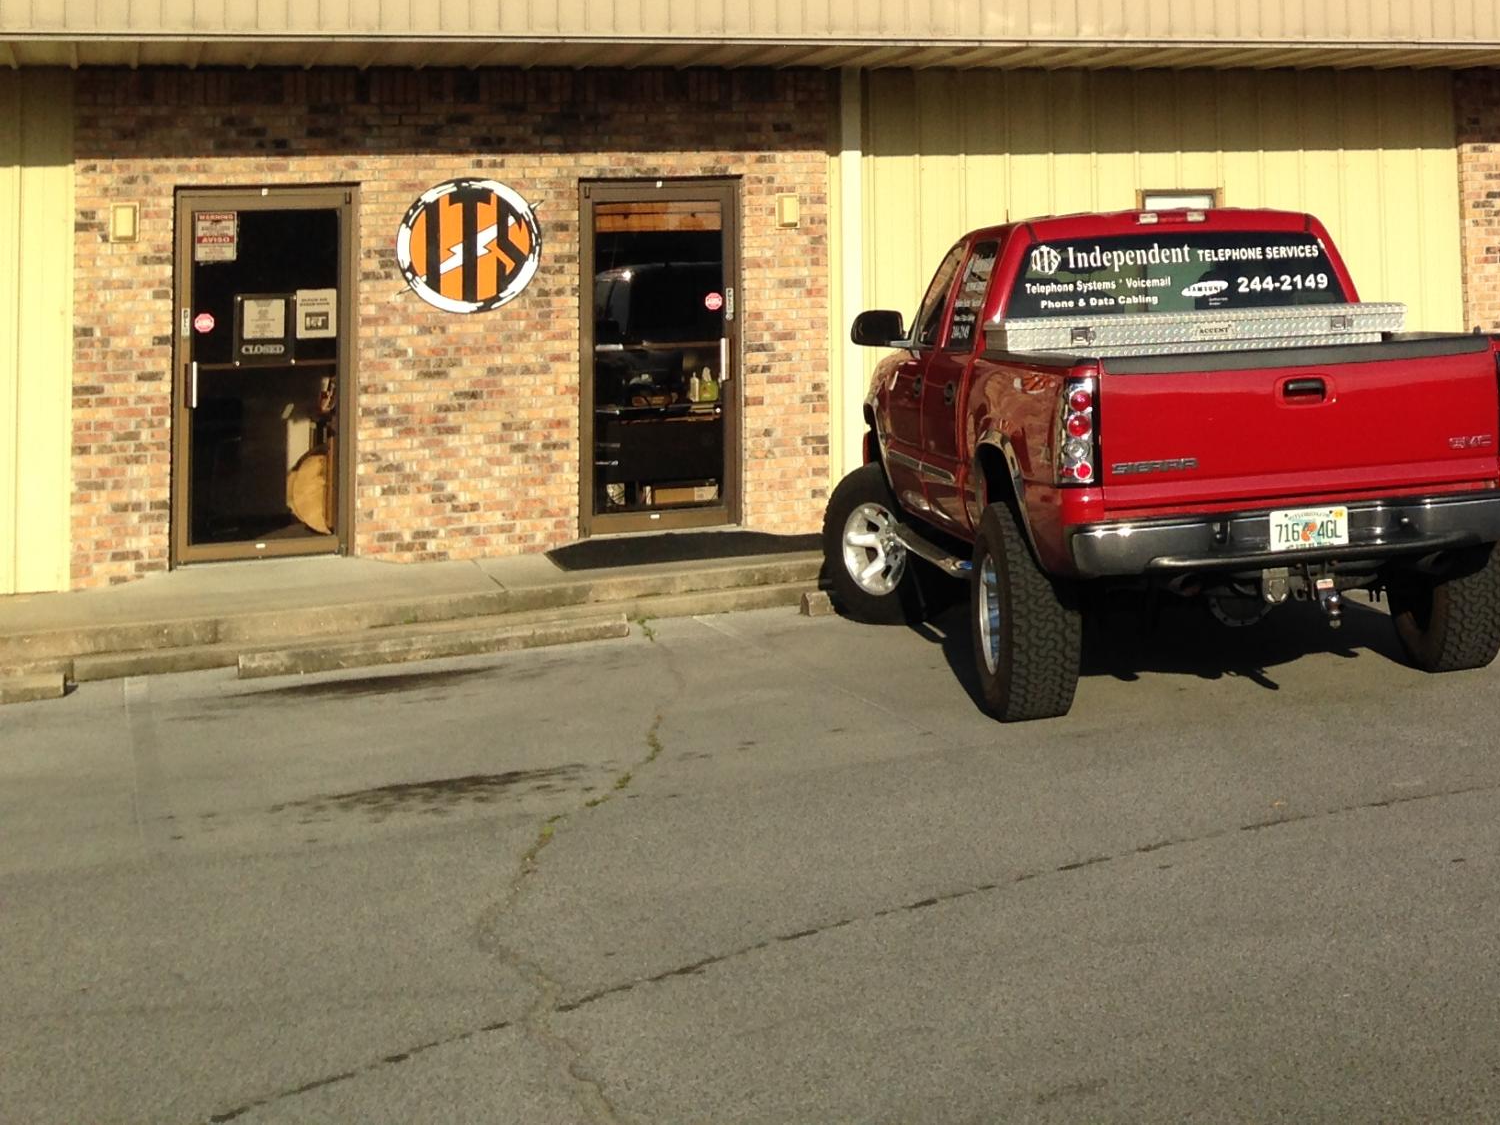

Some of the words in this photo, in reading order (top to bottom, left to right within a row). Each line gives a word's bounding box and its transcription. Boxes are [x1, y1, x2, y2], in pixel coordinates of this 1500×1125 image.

[202, 236, 230, 244] AVISO
[424, 187, 529, 302] ITS
[1067, 243, 1191, 272] Independent
[1197, 246, 1263, 262] TELEPHONE
[1265, 244, 1319, 259] SERVICES
[1025, 283, 1075, 296] Telephone
[1076, 280, 1117, 293] Systems
[1125, 276, 1171, 289] Voicemail
[1237, 273, 1328, 293] 244-2149
[1040, 300, 1075, 309] Phone
[1078, 298, 1086, 307] &
[1089, 297, 1115, 307] Data
[1118, 294, 1158, 306] Cabling
[241, 344, 285, 355] CLOSED
[1111, 458, 1198, 475] SIERRA
[1275, 523, 1300, 543] 716
[1317, 520, 1342, 539] 4GL
